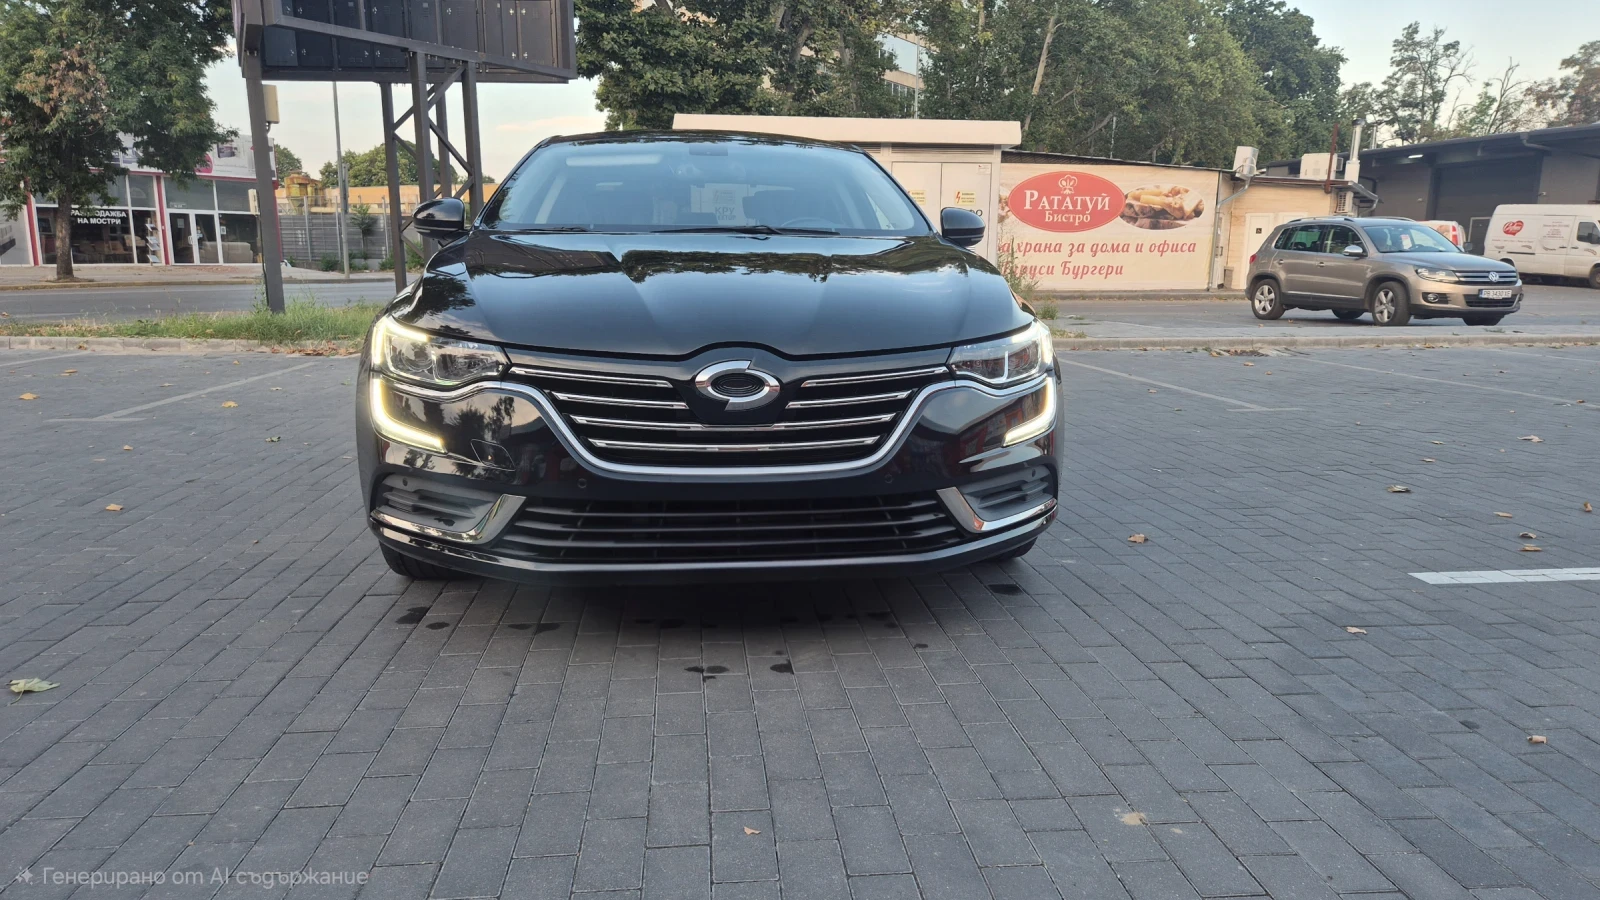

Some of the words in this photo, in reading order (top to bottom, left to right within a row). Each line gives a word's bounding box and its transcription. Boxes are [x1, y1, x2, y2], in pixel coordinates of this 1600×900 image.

[77, 217, 89, 225] НА
[90, 217, 122, 225] МОСТРИ
[1044, 210, 1091, 226] Бистро
[1015, 241, 1062, 257] храна
[1068, 241, 1085, 257] за
[1090, 241, 1130, 257] дома
[1135, 241, 1144, 253] и
[1148, 239, 1197, 257] офиса
[1060, 260, 1124, 280] Бургери
